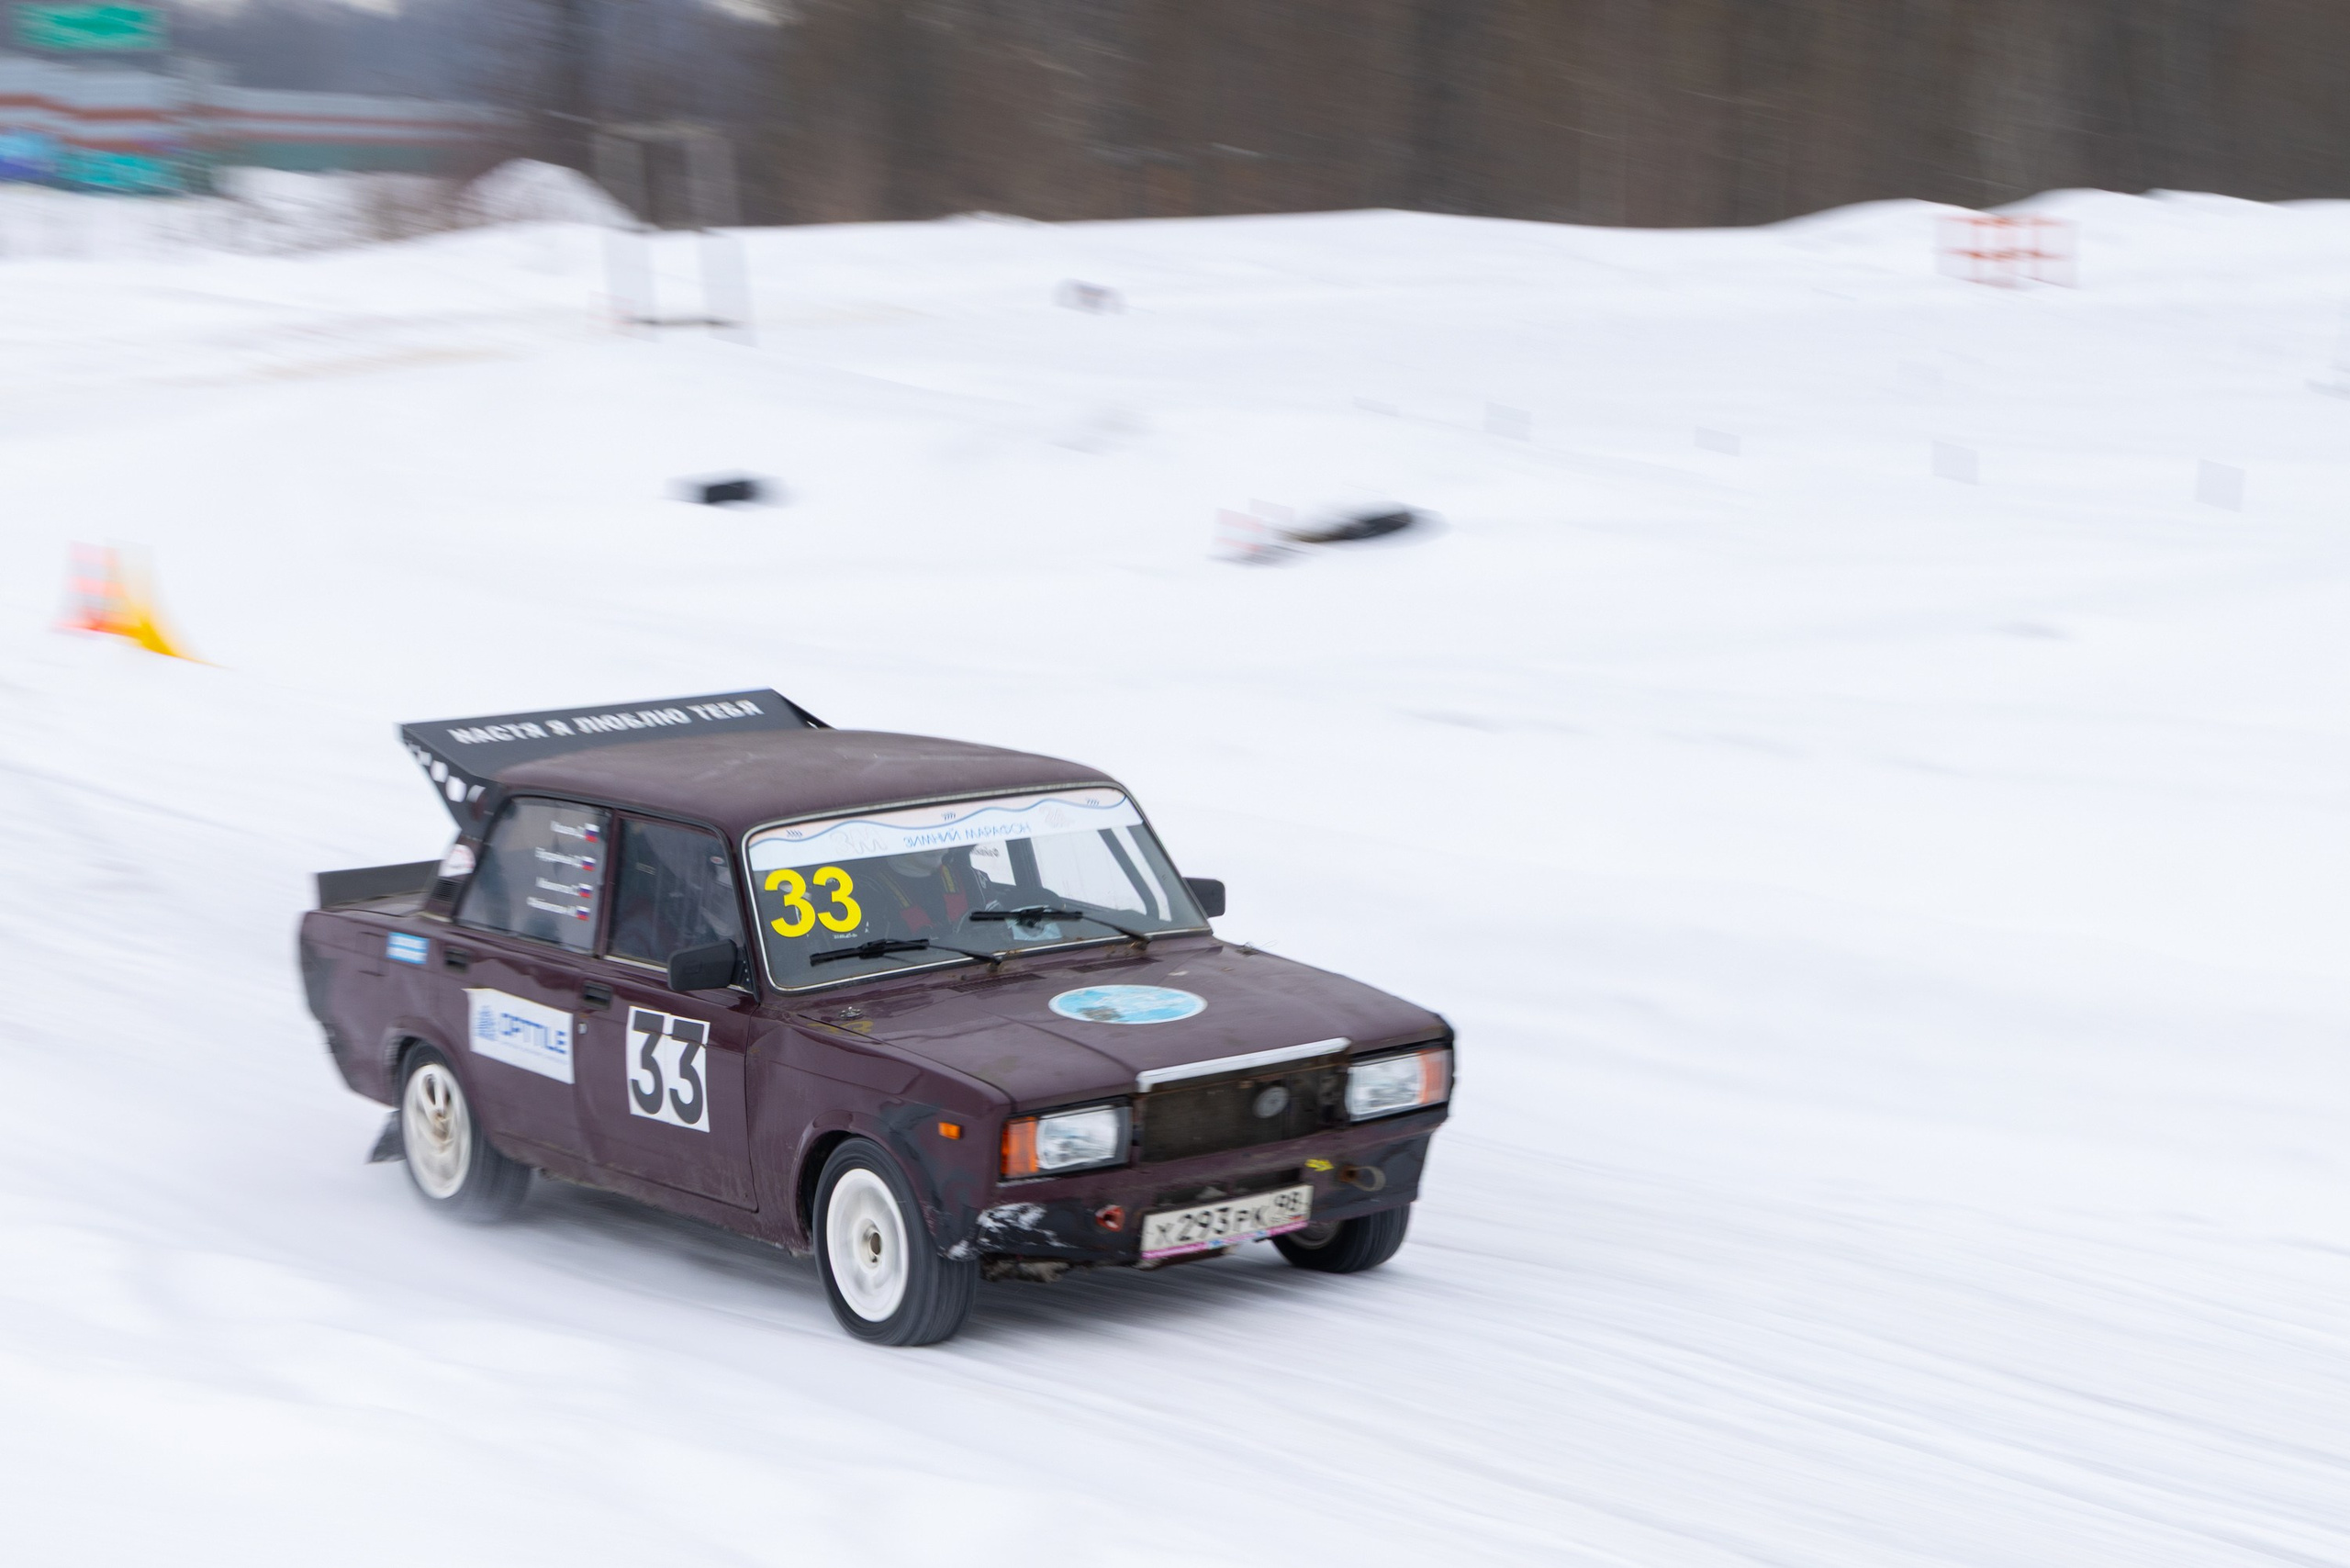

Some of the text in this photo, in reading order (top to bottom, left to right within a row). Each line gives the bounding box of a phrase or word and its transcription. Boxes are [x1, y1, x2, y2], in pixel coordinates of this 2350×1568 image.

[446, 699, 766, 745] НАСТЯ Я ЛЮБЛЮ ТЕБЯ
[764, 866, 862, 937] 33
[630, 1010, 705, 1125] 33
